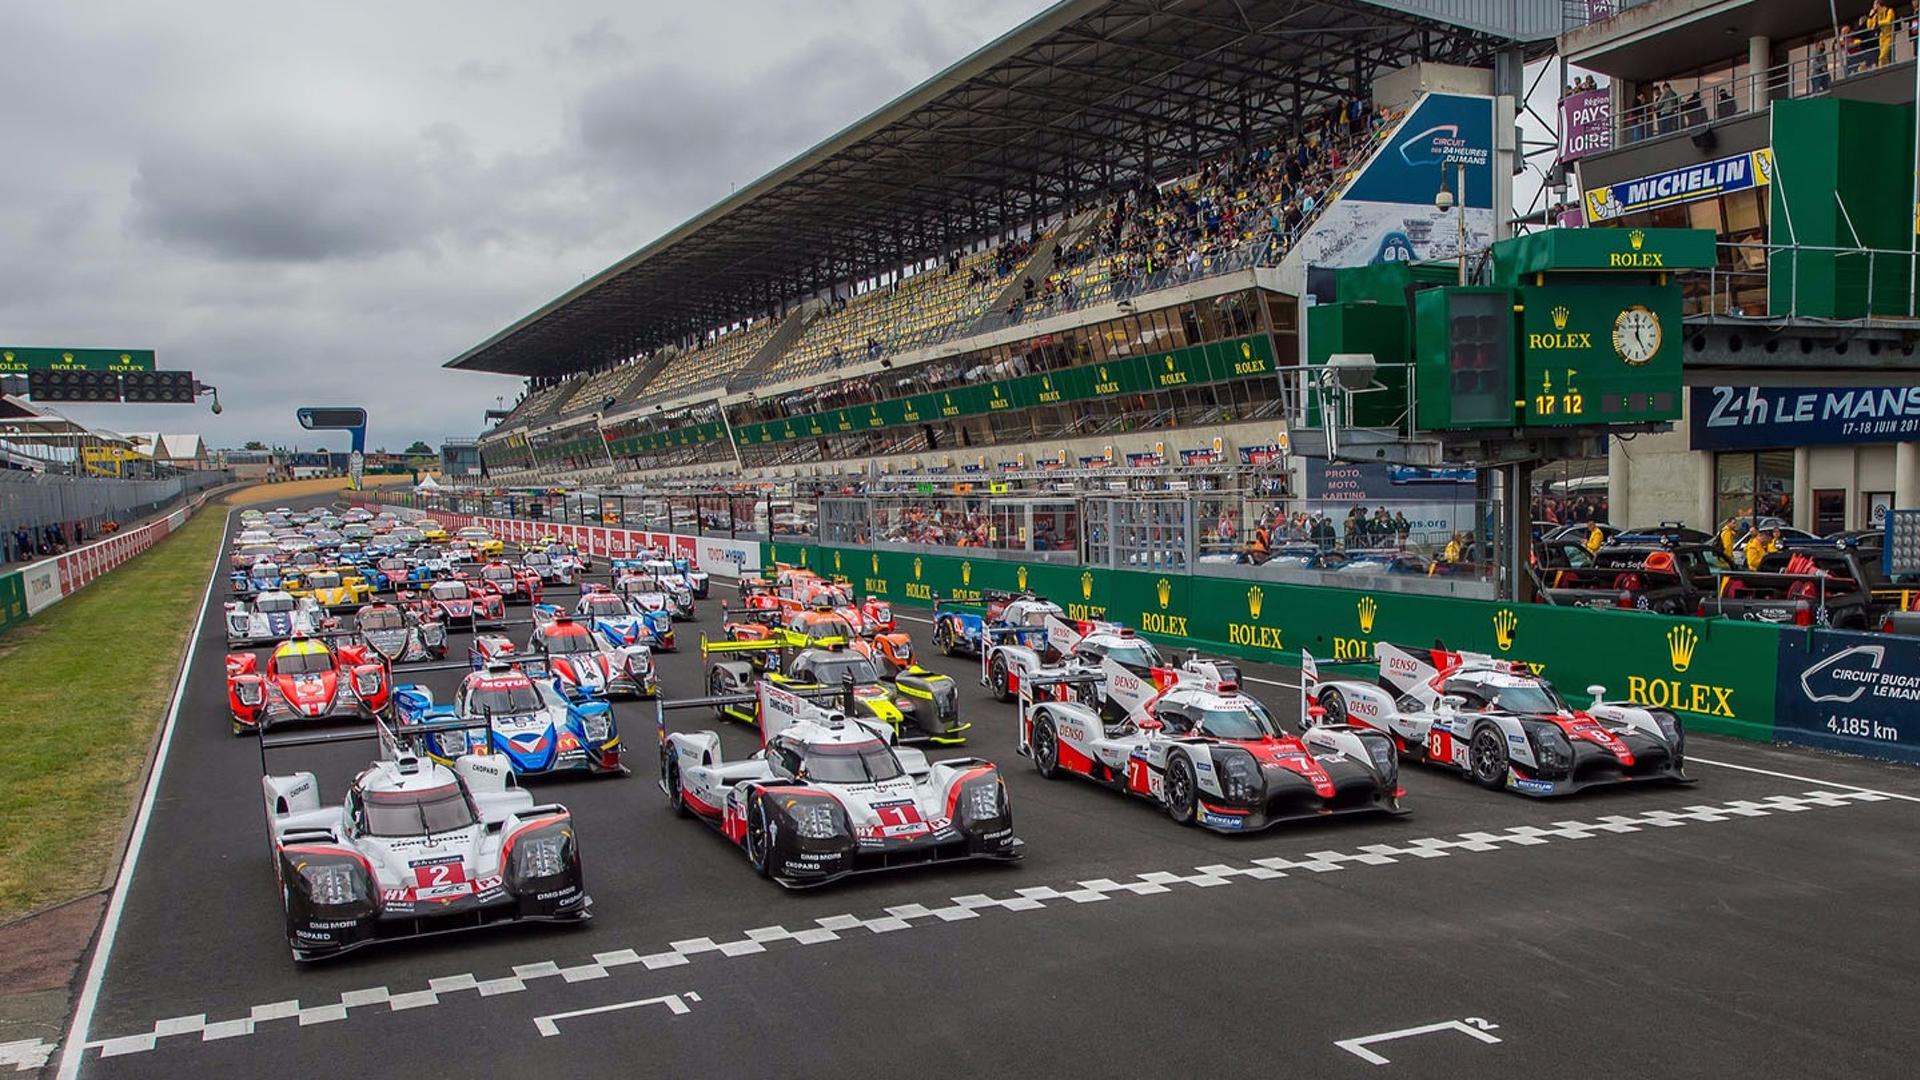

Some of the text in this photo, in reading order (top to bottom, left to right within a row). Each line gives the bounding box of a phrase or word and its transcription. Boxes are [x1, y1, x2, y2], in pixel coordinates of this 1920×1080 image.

[1573, 104, 1610, 127] PAYS
[1432, 138, 1466, 147] CIRCUIT
[1569, 131, 1611, 153] LOIRE
[1442, 146, 1454, 154] 24
[1454, 148, 1488, 157] HEURES
[1446, 155, 1487, 165] DU MANS
[1627, 158, 1746, 204] MICHELIN
[1610, 253, 1664, 267] ROLEX
[1529, 333, 1592, 349] ROLEX
[1234, 359, 1266, 374] ROLEX
[1160, 371, 1188, 386] ROLEX
[1536, 395, 1582, 415] 17 12
[1706, 386, 1920, 428] 24h LE MANS
[1842, 419, 1920, 435] 17-18 JUIN 201
[1626, 561, 1645, 570] Safe
[865, 578, 888, 594] ROLEX
[906, 582, 931, 599] ROLEX
[1142, 612, 1189, 637] ROLEX
[1053, 627, 1070, 638] DENSO
[1228, 623, 1284, 650] ROLEX
[1333, 636, 1377, 659] ROL
[1389, 658, 1418, 672] DENSO
[1114, 674, 1140, 690] DENSO
[1832, 668, 1880, 683] CIRCUIT
[481, 680, 532, 688] MOTUL
[1873, 685, 1889, 697] LE
[1627, 676, 1735, 718] ROLEX
[1350, 700, 1378, 717] DENSO
[1060, 724, 1084, 742] DENSO
[1827, 714, 1898, 741] 4,185 km
[1590, 730, 1612, 742] 8
[1432, 734, 1442, 756] 8
[1455, 747, 1466, 760] P1
[472, 763, 499, 776] CHOPARD
[1290, 757, 1309, 769] 7
[1131, 762, 1140, 787] 7
[1152, 778, 1160, 791] P1
[889, 807, 909, 825] 1
[930, 818, 950, 828] P1
[1206, 815, 1241, 826] MICHELIN
[856, 826, 875, 837] HY
[785, 860, 821, 870] CHOPARD
[429, 865, 452, 886] 2
[480, 876, 500, 888] P1
[384, 888, 408, 901] HY
[537, 891, 559, 901] DMG
[309, 920, 358, 930] DMG MORI
[295, 929, 331, 940] CHOPARD
[683, 991, 702, 1002] 1
[1464, 1017, 1500, 1030] 2
